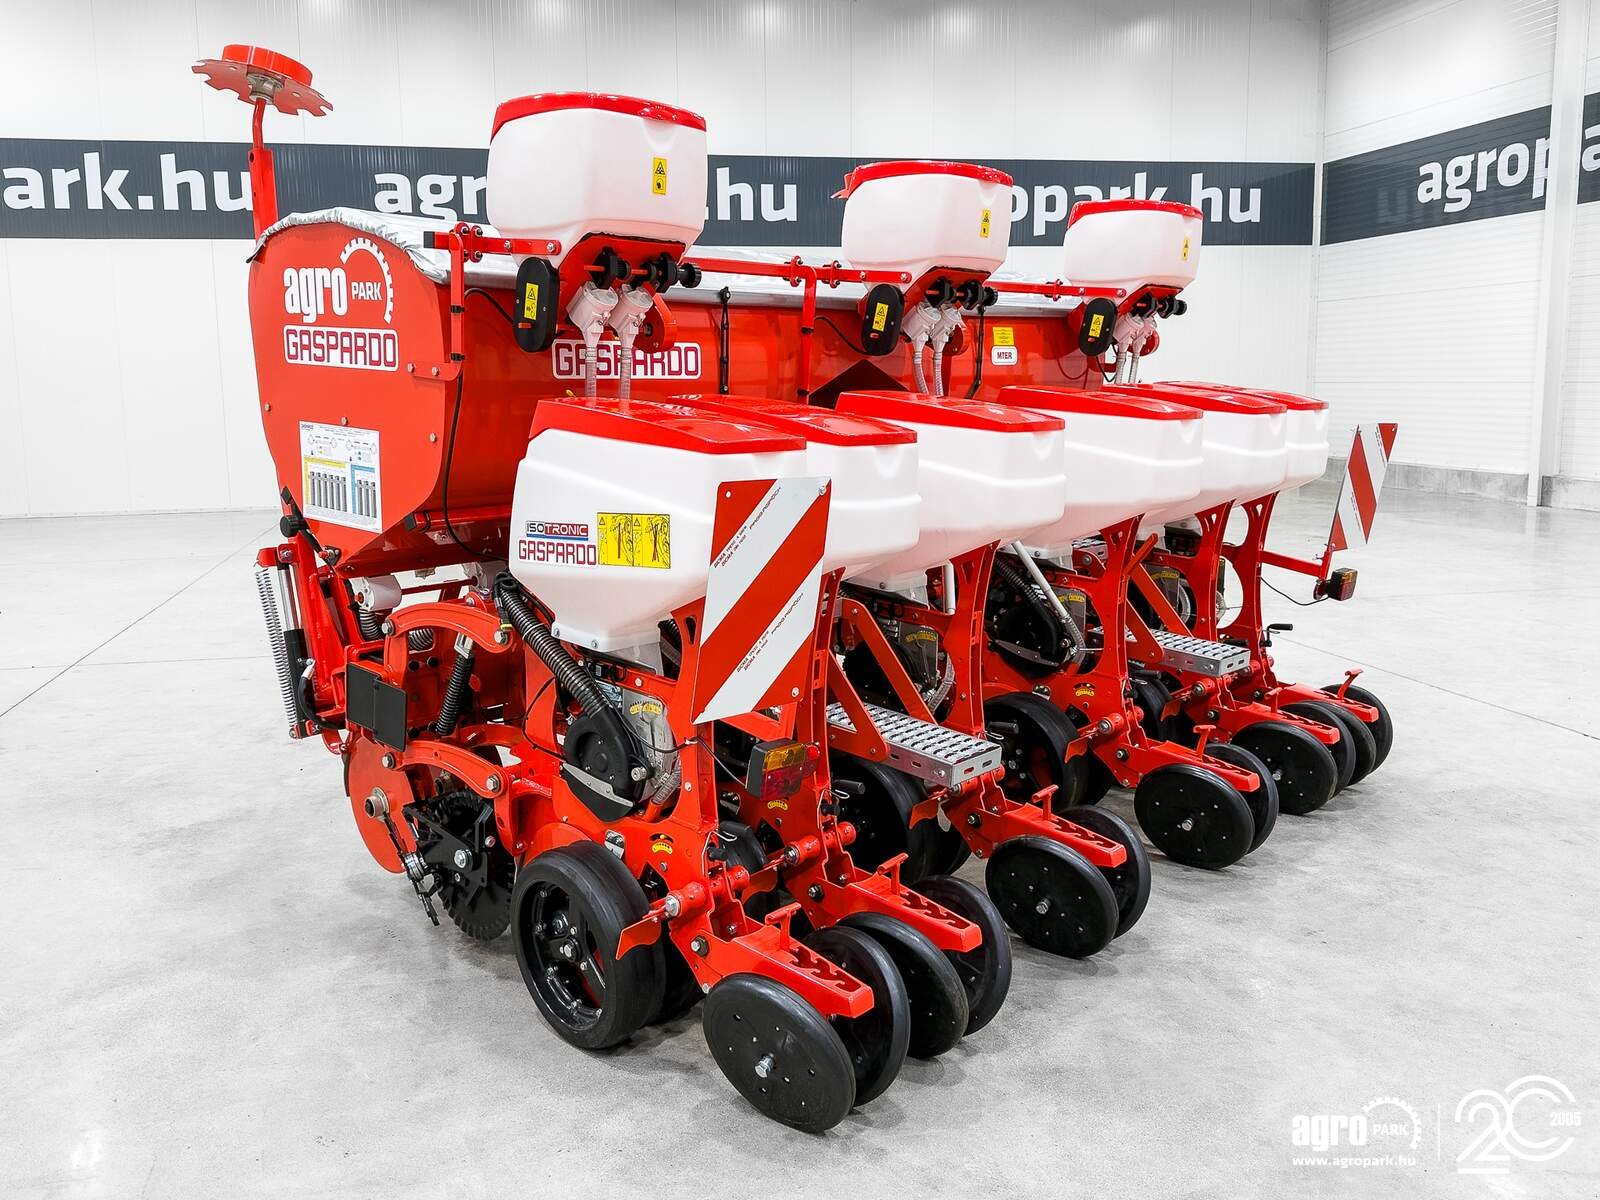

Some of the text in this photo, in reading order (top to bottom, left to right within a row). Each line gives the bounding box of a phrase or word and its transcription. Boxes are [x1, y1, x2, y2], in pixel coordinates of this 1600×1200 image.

[283, 267, 382, 323] agro PARK
[286, 329, 397, 367] GASPARDO
[527, 521, 588, 536] ISOTRONIC
[518, 540, 597, 565] GASPARDO
